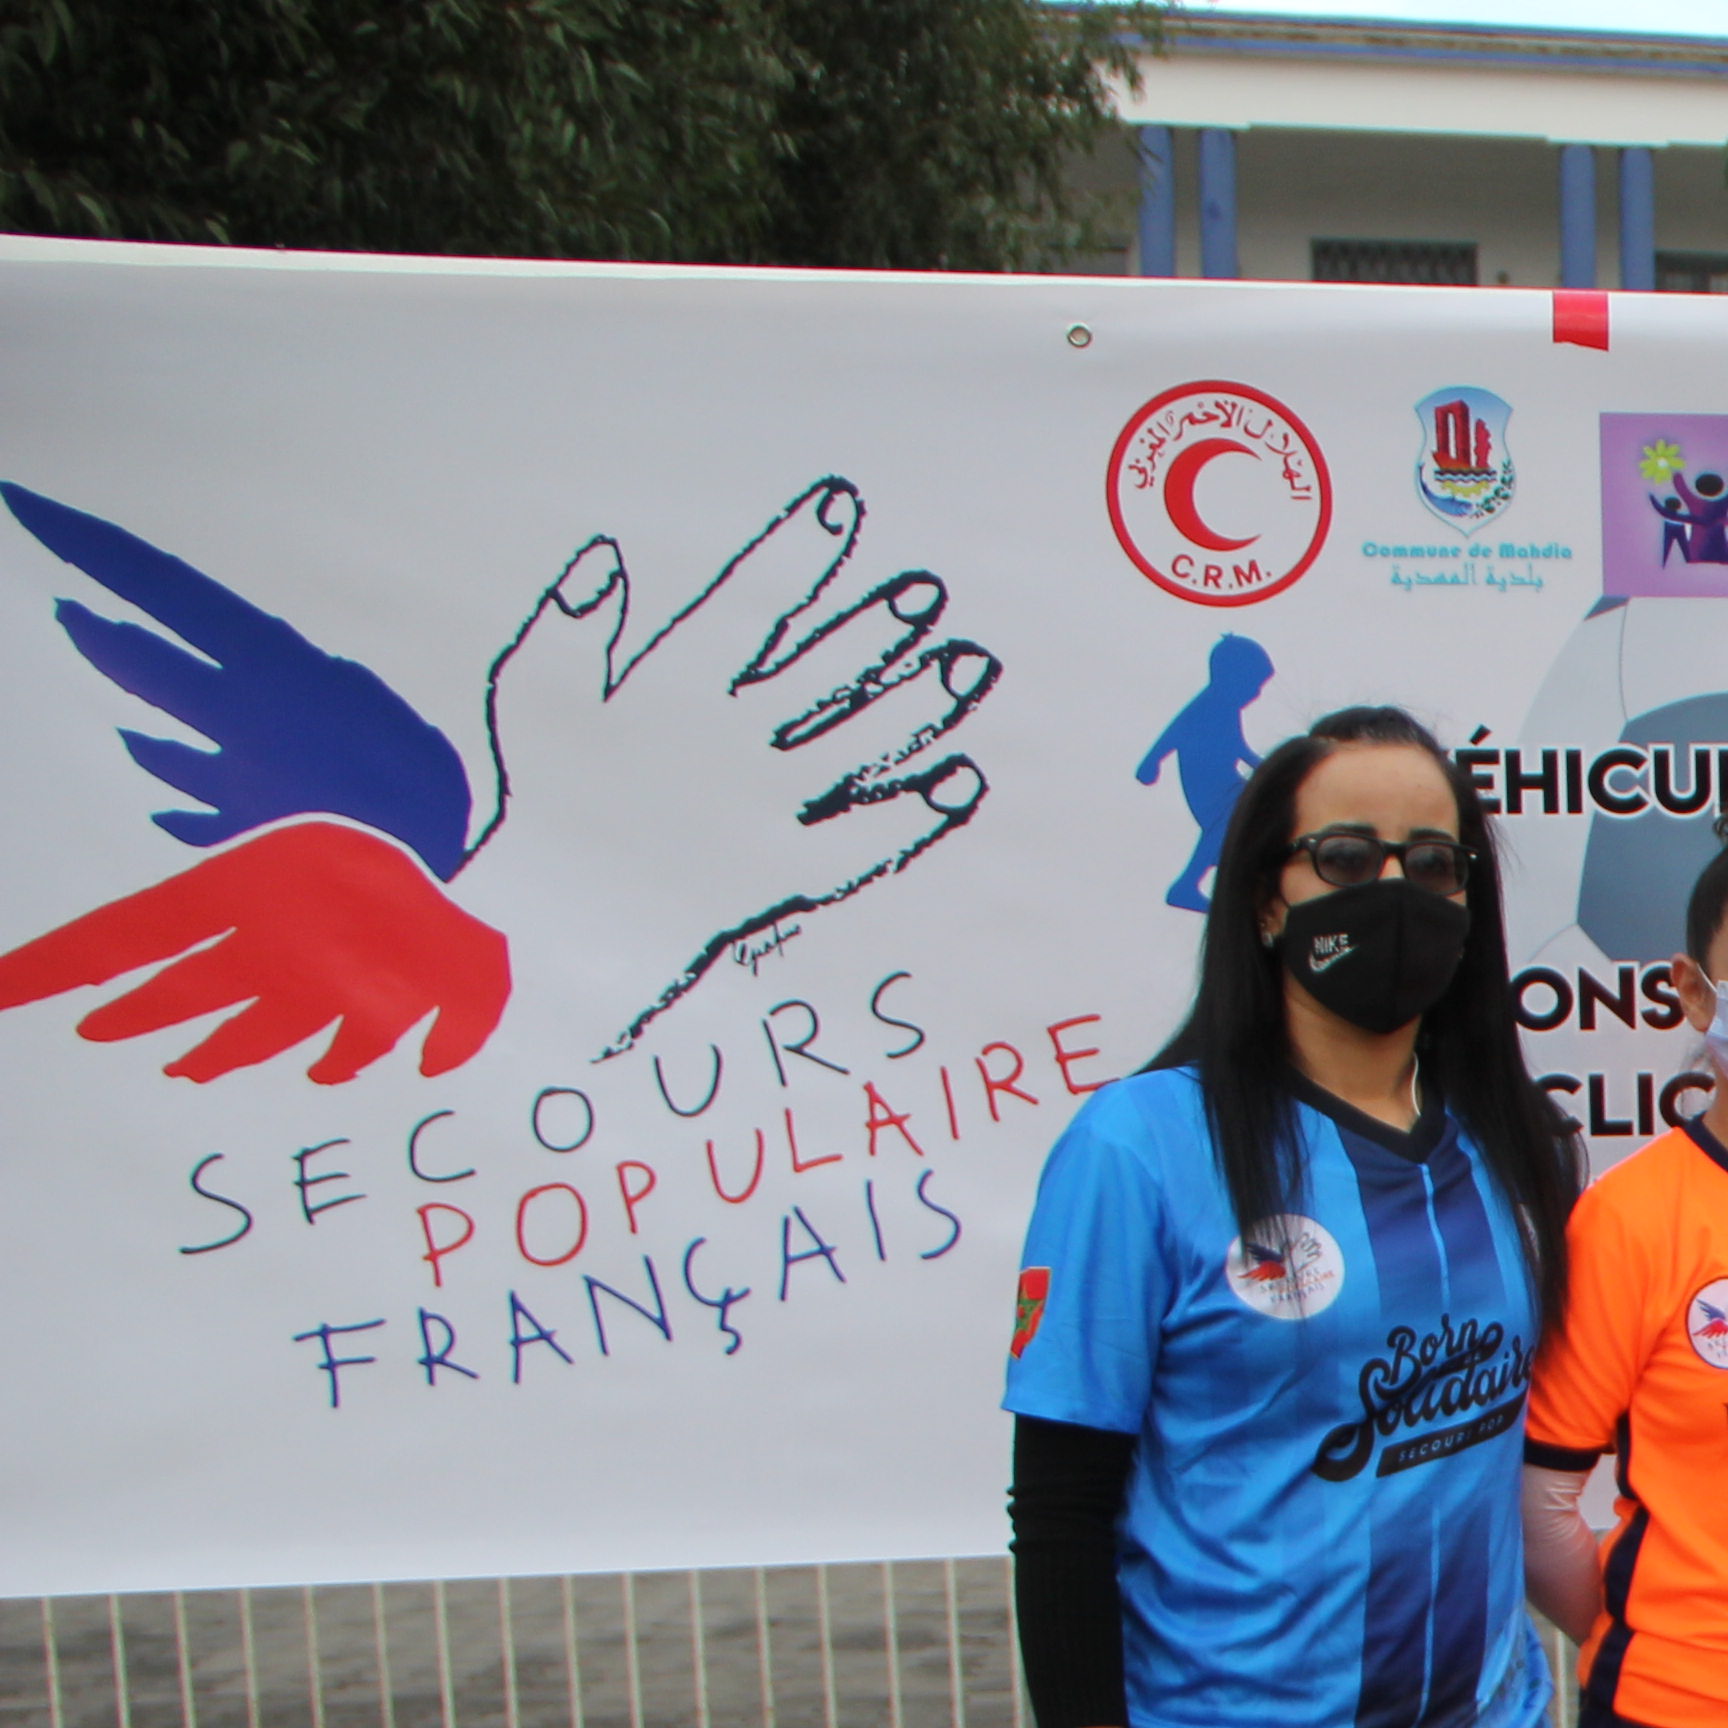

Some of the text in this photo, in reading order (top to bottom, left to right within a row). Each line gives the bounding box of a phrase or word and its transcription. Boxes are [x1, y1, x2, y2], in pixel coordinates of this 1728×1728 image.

[1171, 553, 1272, 590] C.R.M.
[1362, 541, 1573, 559] Commune de Mahdia
[1313, 933, 1350, 955] NIKE
[180, 971, 926, 1255] SECOURS
[417, 1012, 1123, 1287] POPULAIRE
[293, 1168, 961, 1408] FRANÇAIS
